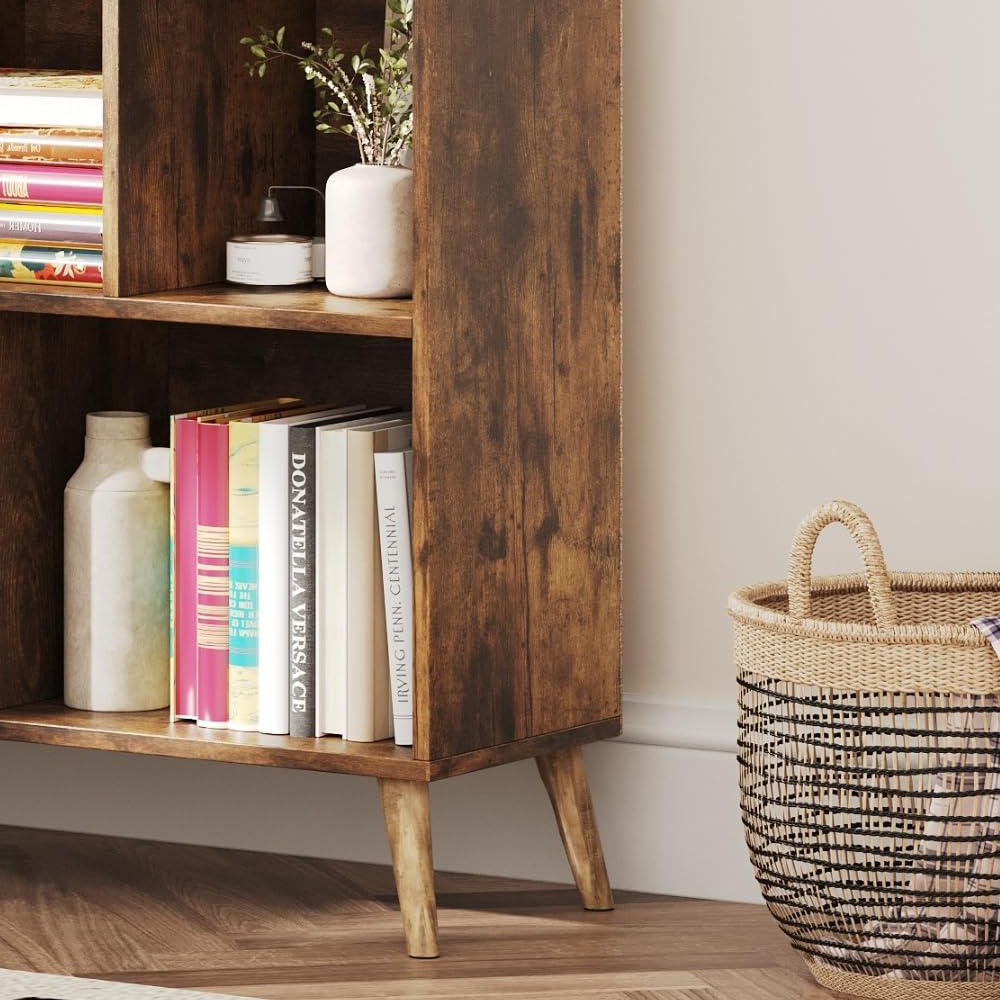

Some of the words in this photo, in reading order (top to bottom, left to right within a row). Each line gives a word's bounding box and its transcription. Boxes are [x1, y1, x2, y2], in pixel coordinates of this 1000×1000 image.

[291, 453, 307, 597] DONATELLA
[385, 505, 402, 595] CENTENNIAL
[291, 603, 307, 713] VERSACE
[393, 601, 404, 643] PENN:
[397, 648, 409, 703] IRVING
